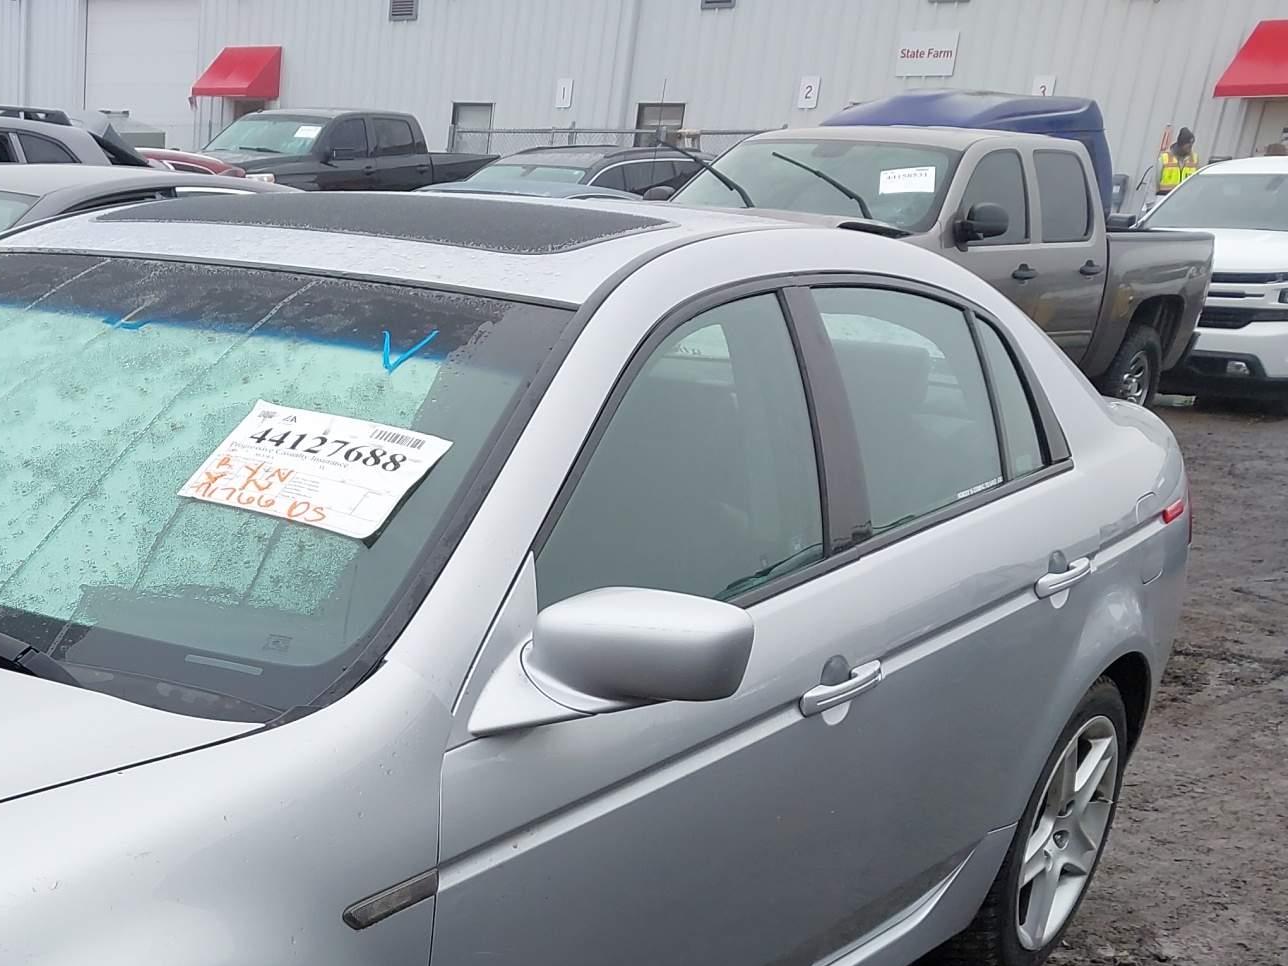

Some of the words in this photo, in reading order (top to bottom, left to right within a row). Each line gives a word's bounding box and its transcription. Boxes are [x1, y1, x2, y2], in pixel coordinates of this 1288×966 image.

[900, 48, 926, 59] State
[927, 48, 953, 59] Farm
[804, 85, 813, 99] 2
[249, 427, 407, 472] 44127688
[311, 455, 350, 469] Insurance
